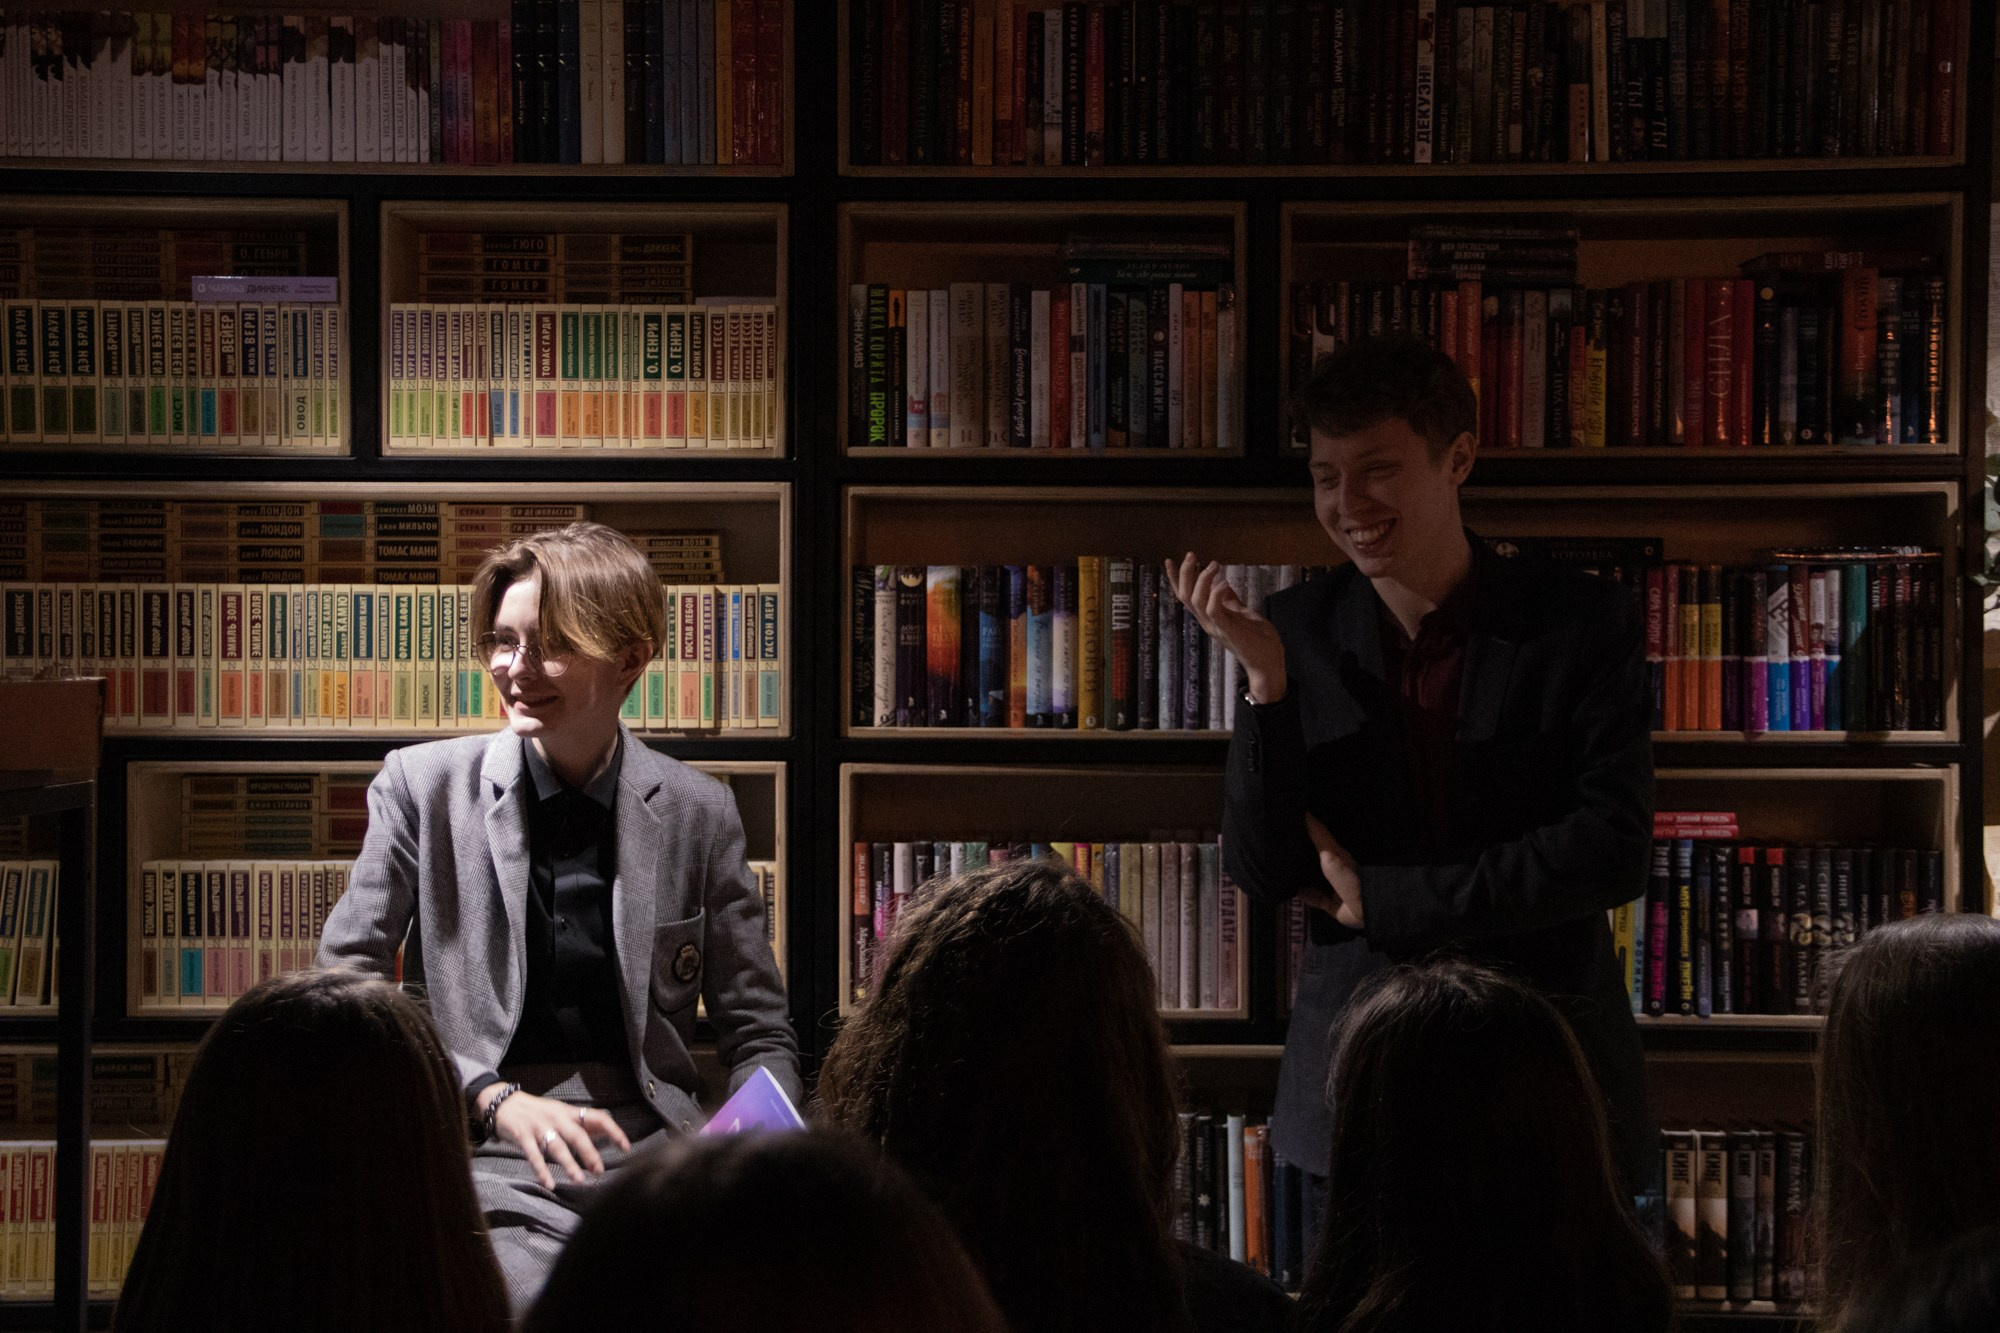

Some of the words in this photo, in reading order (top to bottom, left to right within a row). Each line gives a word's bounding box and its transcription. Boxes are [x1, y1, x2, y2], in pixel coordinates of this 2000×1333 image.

[1332, 8, 1343, 39] ХЕЛЕН
[382, 54, 390, 100] ВЕЛИКИЙ
[396, 55, 404, 100] ВЕЛИКИЙ
[79, 75, 89, 150] КОЛЛЕКЦИОНЕР
[192, 94, 200, 128] ЖИЗНЬ
[382, 102, 390, 138] ГЭТСБИ
[396, 102, 404, 138] ГЭТСБИ
[513, 239, 544, 250] ГЮГО
[493, 260, 540, 270] ГОМЕР
[493, 280, 540, 291] ГОМЕР
[15, 309, 27, 345] БРАУН
[47, 311, 60, 347] БРАУН
[77, 311, 88, 346] БРАУН
[151, 312, 162, 348] БЭНКС
[172, 312, 182, 348] БЭНКС
[244, 313, 255, 344] ВЕРН
[265, 312, 276, 344] ВЕРН
[314, 313, 322, 354] ВОННЕГУТ
[329, 313, 337, 354] ВОННЕГУТ
[394, 314, 402, 355] ВОННЕГУТ
[408, 314, 416, 355] ВОННЕГУТ
[422, 314, 430, 354] ВОННЕГУТ
[451, 315, 460, 356] ВОННЕГУТ
[464, 314, 473, 345] ВУДХАУС
[478, 314, 487, 346] ВУДХАУС
[542, 317, 551, 346] ГАРДИ
[692, 316, 702, 349] ГЕРБЕРТ
[712, 319, 722, 347] ГЕССЕ
[730, 318, 739, 347] ГЕССЕ
[743, 316, 751, 347] ГЕССЕ
[754, 317, 762, 346] ГЕССЕ
[853, 308, 864, 332] ЭНН
[437, 316, 445, 356] ВОННЕГУТ
[648, 323, 659, 359] ГЕНРИ
[672, 322, 682, 359] ГЕНРИ
[853, 333, 863, 368] КЛИВЗ
[17, 349, 29, 372] ДЭН
[49, 351, 62, 373] ДЭН
[78, 350, 90, 373] ДЭН
[152, 352, 162, 374] ИЭН
[172, 352, 182, 373] ИЭН
[314, 356, 322, 377] КУРТ
[329, 356, 337, 377] КУРТ
[394, 357, 402, 377] КУРТ
[408, 357, 416, 377] КУРТ
[422, 356, 430, 377] КУРТ
[437, 358, 445, 378] КУРТ
[451, 358, 460, 378] КУРТ
[542, 347, 551, 376] ТОМАС
[648, 362, 659, 373] О.
[672, 362, 682, 373] О.
[692, 350, 702, 378] ФРЭНК
[870, 336, 886, 383] КОРИТА
[296, 396, 306, 430] ОВОД
[869, 392, 886, 442] ПРОРОК
[378, 545, 408, 557] ТОМАС
[410, 545, 436, 557] МАНН
[378, 572, 408, 584] ТОМАС
[410, 572, 436, 584] МАНН
[152, 594, 162, 626] ДРАЙЗЕР
[182, 594, 191, 626] ДРАЙЗЕР
[227, 596, 237, 621] ЗОЛЯ
[252, 595, 262, 621] ЗОЛЯ
[322, 594, 332, 622] КАМЮ
[399, 596, 409, 626] КАФКА
[422, 595, 432, 625] КАФКА
[443, 597, 453, 626] КАФКА
[460, 595, 468, 618] КЕЙН
[684, 598, 694, 624] ЛЕБОН
[764, 595, 774, 620] ЛЕРУ
[1112, 594, 1131, 630] BELLA
[152, 627, 162, 655] ТЕОДОР
[182, 627, 191, 655] ТЕОДОР
[227, 624, 237, 657] ЭМИЛЬ
[252, 623, 262, 656] ЭМИЛЬ
[322, 624, 332, 657] АЛЬБЕР
[399, 628, 409, 659] ФРАНЦ
[422, 627, 432, 658] ФРАНЦ
[443, 628, 453, 659] ФРАНЦ
[460, 619, 468, 657] ДЖЕЙМС
[684, 625, 694, 658] ГЮСТАВ
[764, 623, 774, 658] ГАСТОН
[337, 683, 346, 714] ЧУМА
[444, 675, 452, 716] ПРОЦЕСС
[145, 873, 156, 901] МАНН
[212, 873, 221, 912] МИТЧЕЛЛ
[235, 873, 245, 912] МИТЧЕЛЛ
[145, 903, 156, 934] ТОМАС
[1797, 951, 1807, 993] ПЛАМЯ
